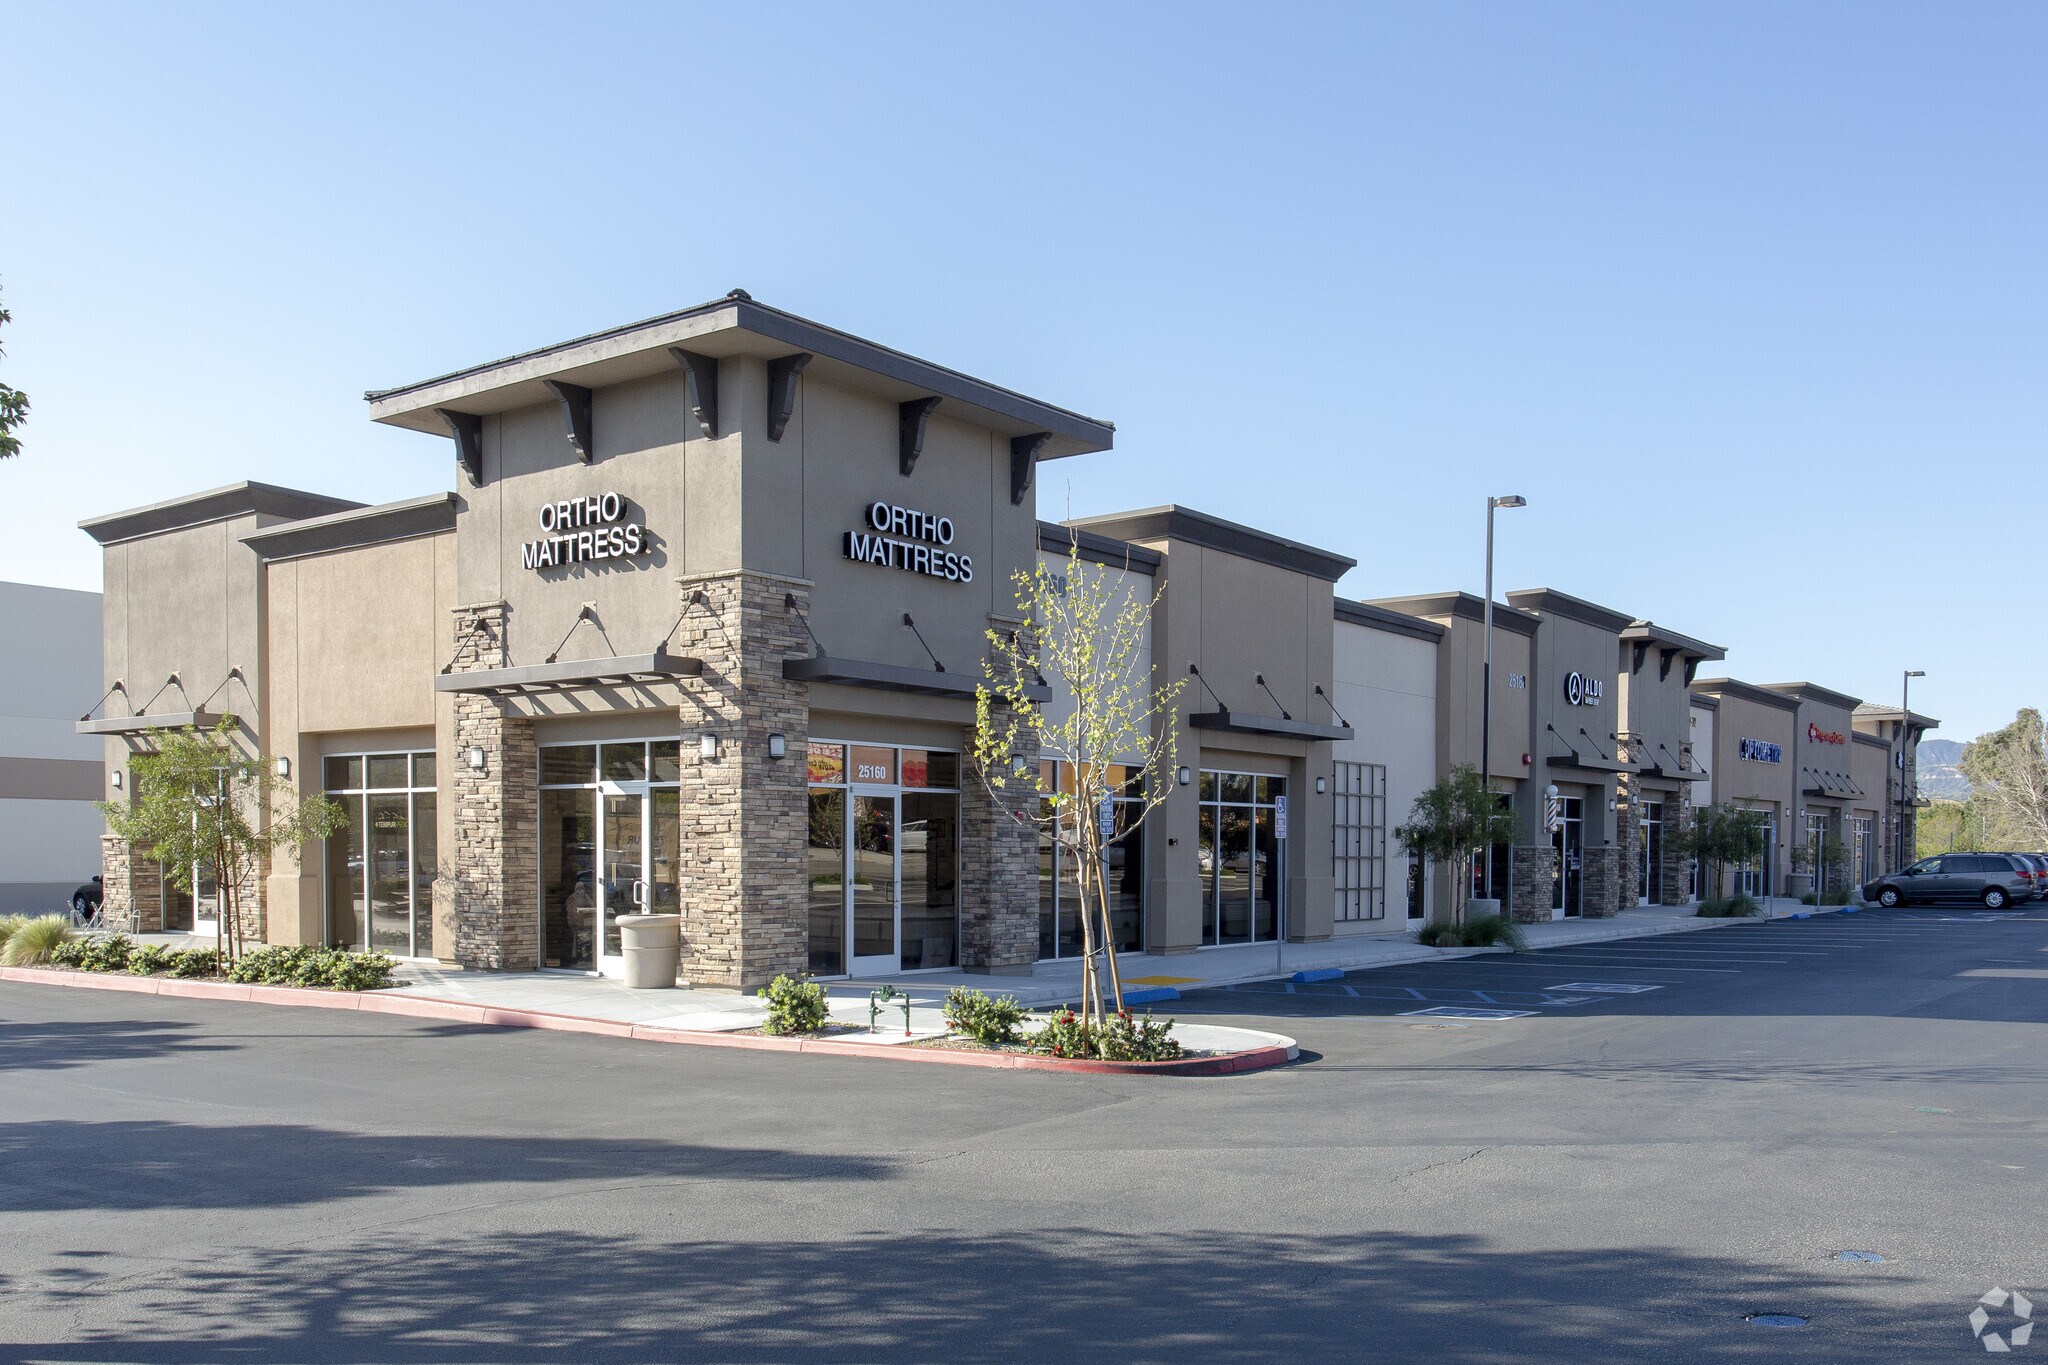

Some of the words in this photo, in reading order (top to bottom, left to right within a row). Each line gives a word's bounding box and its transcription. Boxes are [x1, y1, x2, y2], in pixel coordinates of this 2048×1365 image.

[540, 491, 620, 533] ORTHO
[872, 501, 954, 545] ORTHO
[521, 523, 640, 570] MATTRESS
[850, 531, 973, 583] MATTRESS
[1584, 677, 1603, 698] ALDO
[858, 764, 886, 779] 25160
